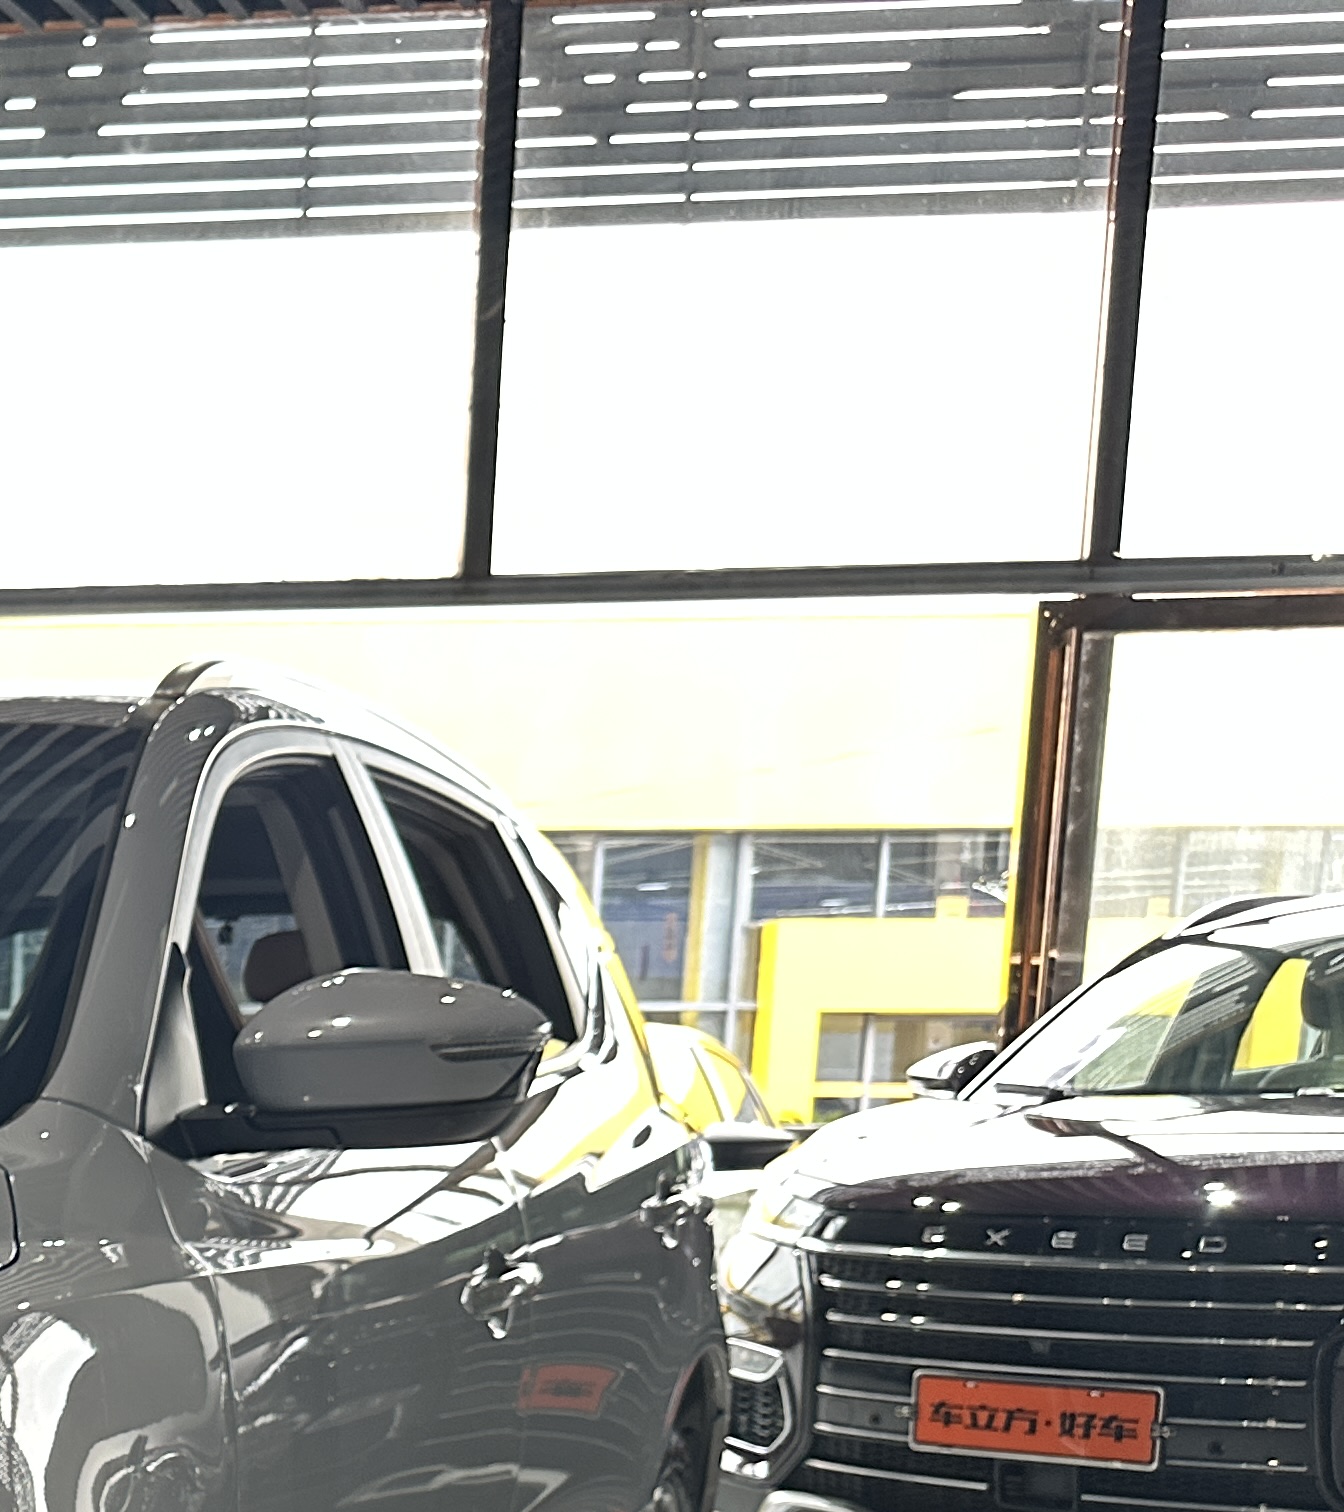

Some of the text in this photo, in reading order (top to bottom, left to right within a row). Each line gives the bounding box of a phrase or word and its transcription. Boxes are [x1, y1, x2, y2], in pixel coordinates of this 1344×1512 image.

[920, 1225, 1228, 1255] EXEED
[929, 1400, 1140, 1444] 车立方·好车
